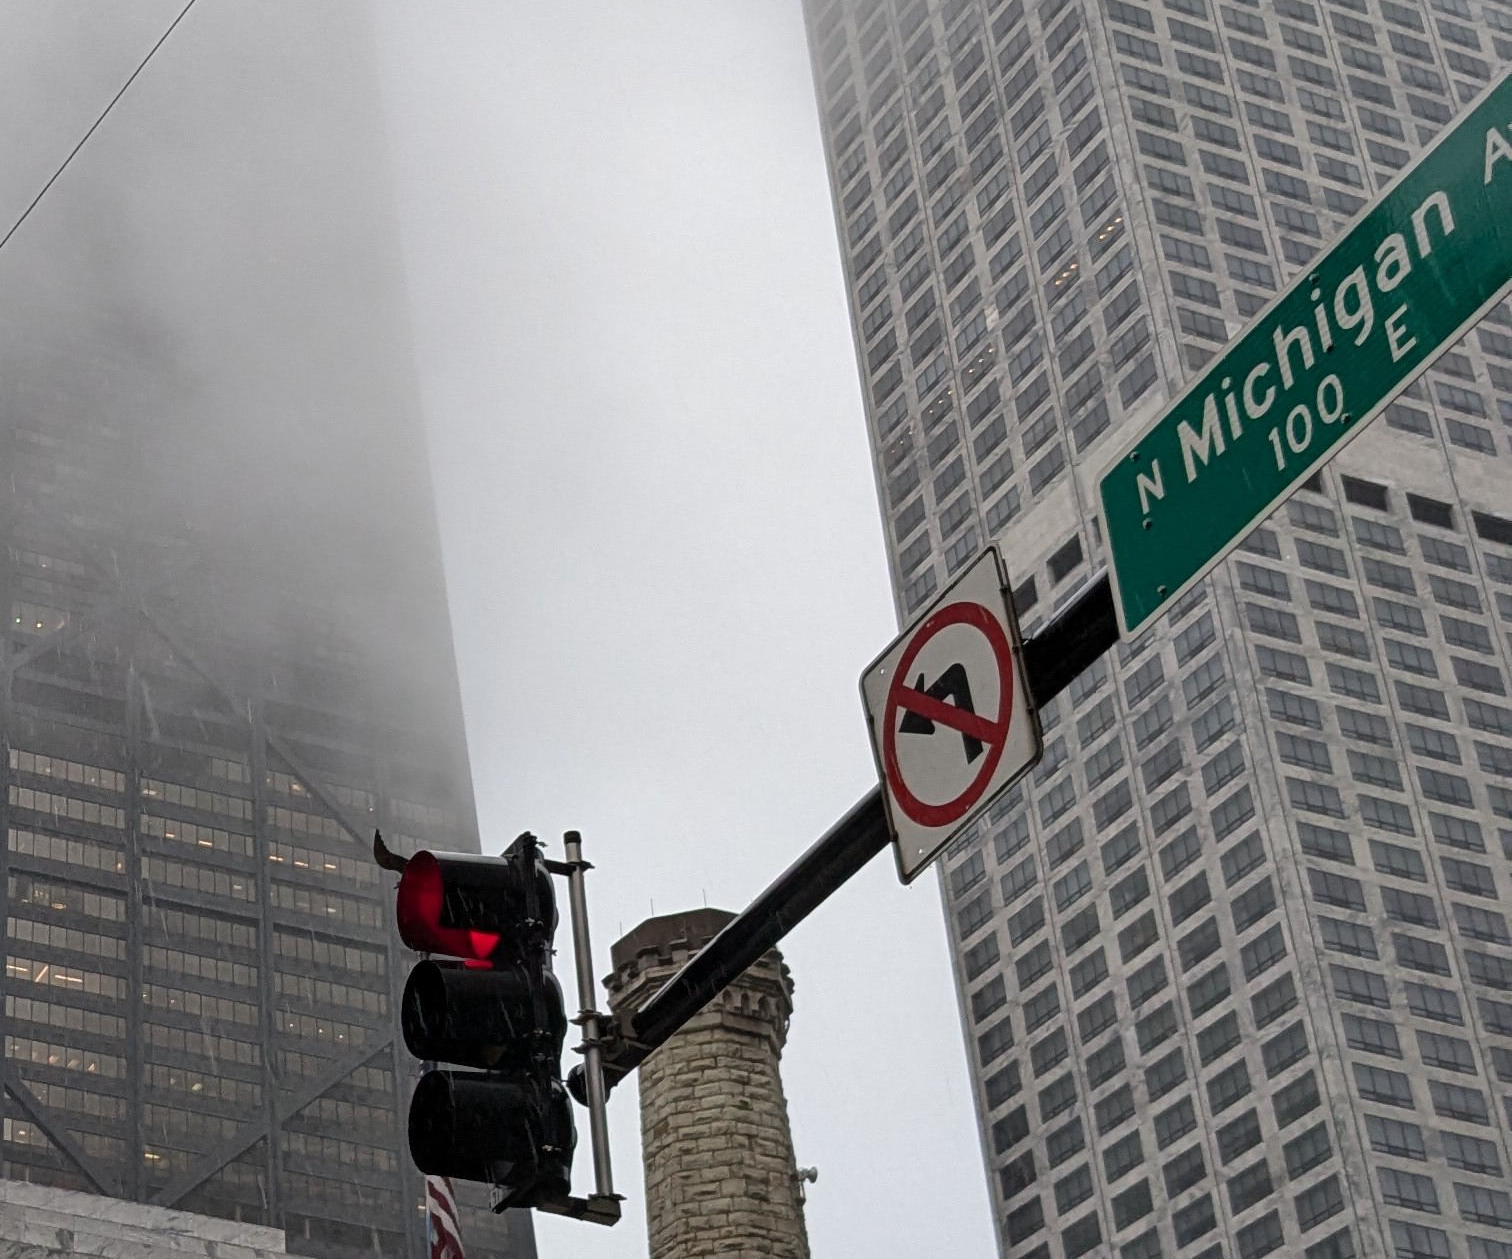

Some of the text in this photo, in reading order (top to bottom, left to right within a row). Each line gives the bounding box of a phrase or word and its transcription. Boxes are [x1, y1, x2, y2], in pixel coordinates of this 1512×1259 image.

[1136, 122, 1512, 514] N Michigan A
[1268, 304, 1417, 471] 100 E
